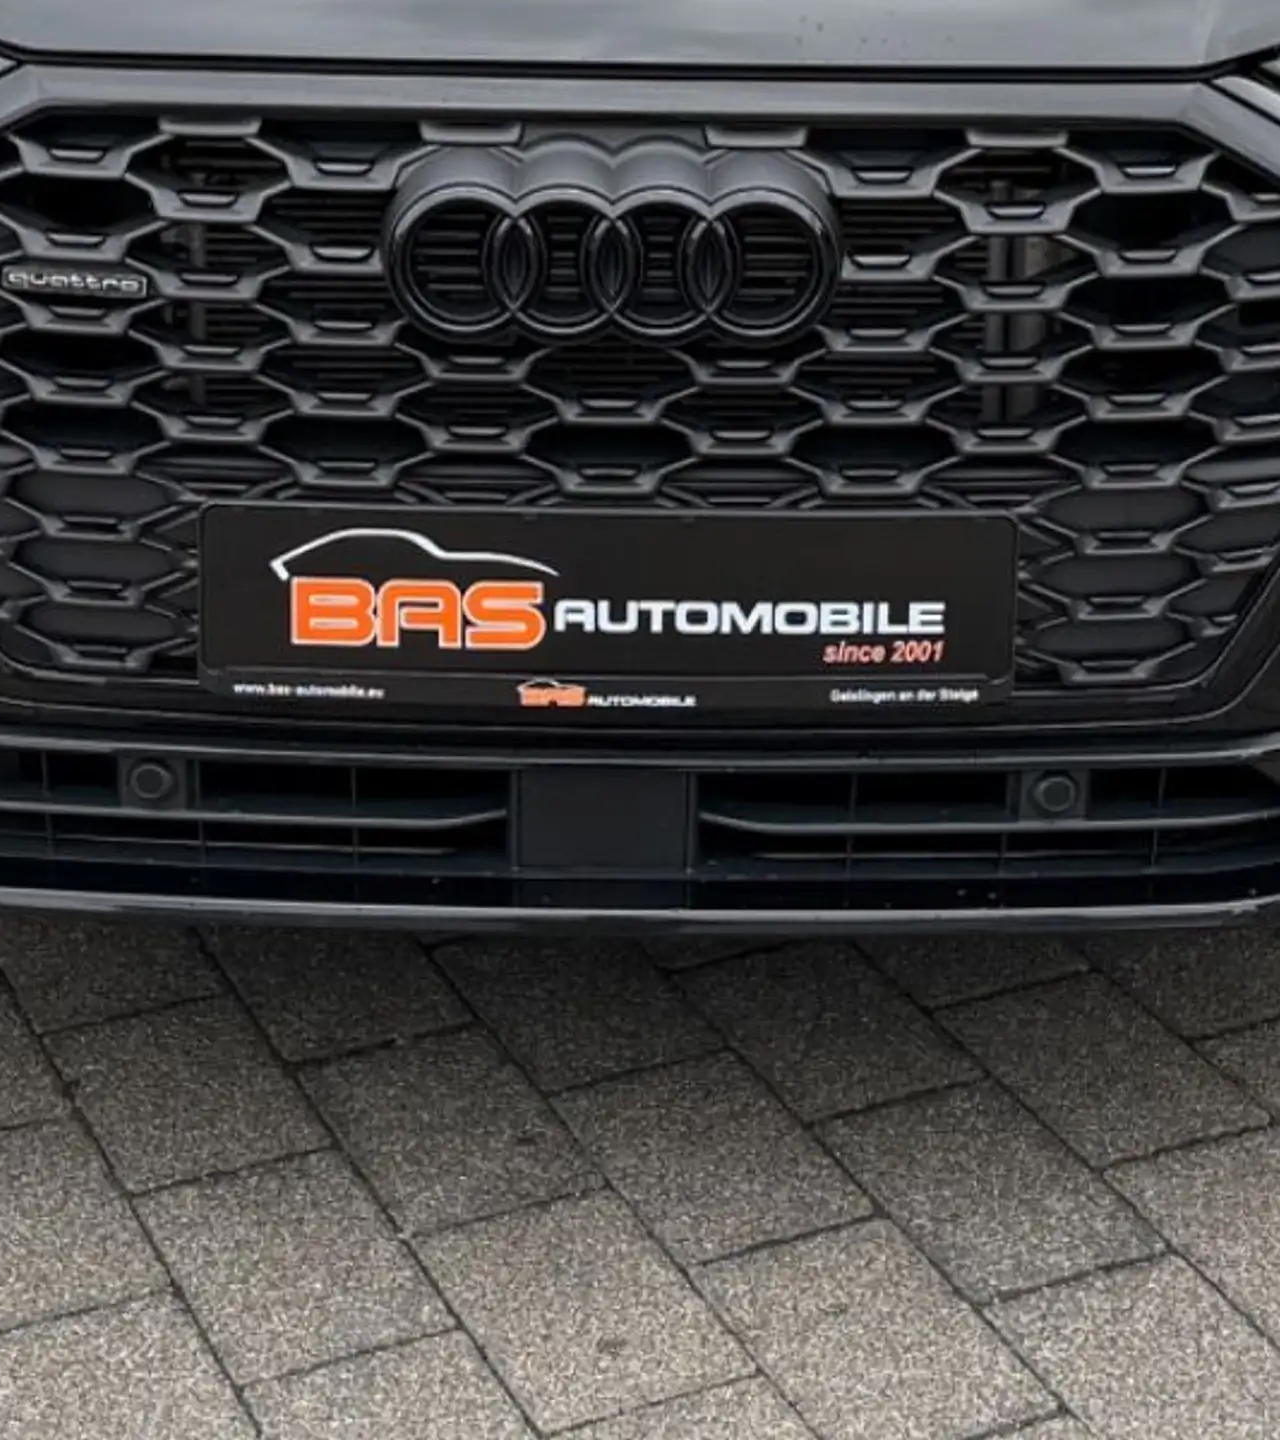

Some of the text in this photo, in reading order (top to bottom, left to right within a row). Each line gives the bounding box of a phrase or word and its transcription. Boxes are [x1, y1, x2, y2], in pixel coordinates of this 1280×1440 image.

[8, 271, 140, 292] quattro
[291, 576, 946, 650] BAS AUTOMOBILE
[822, 640, 945, 664] since 2001
[587, 694, 697, 707] AUTOMOBILE
